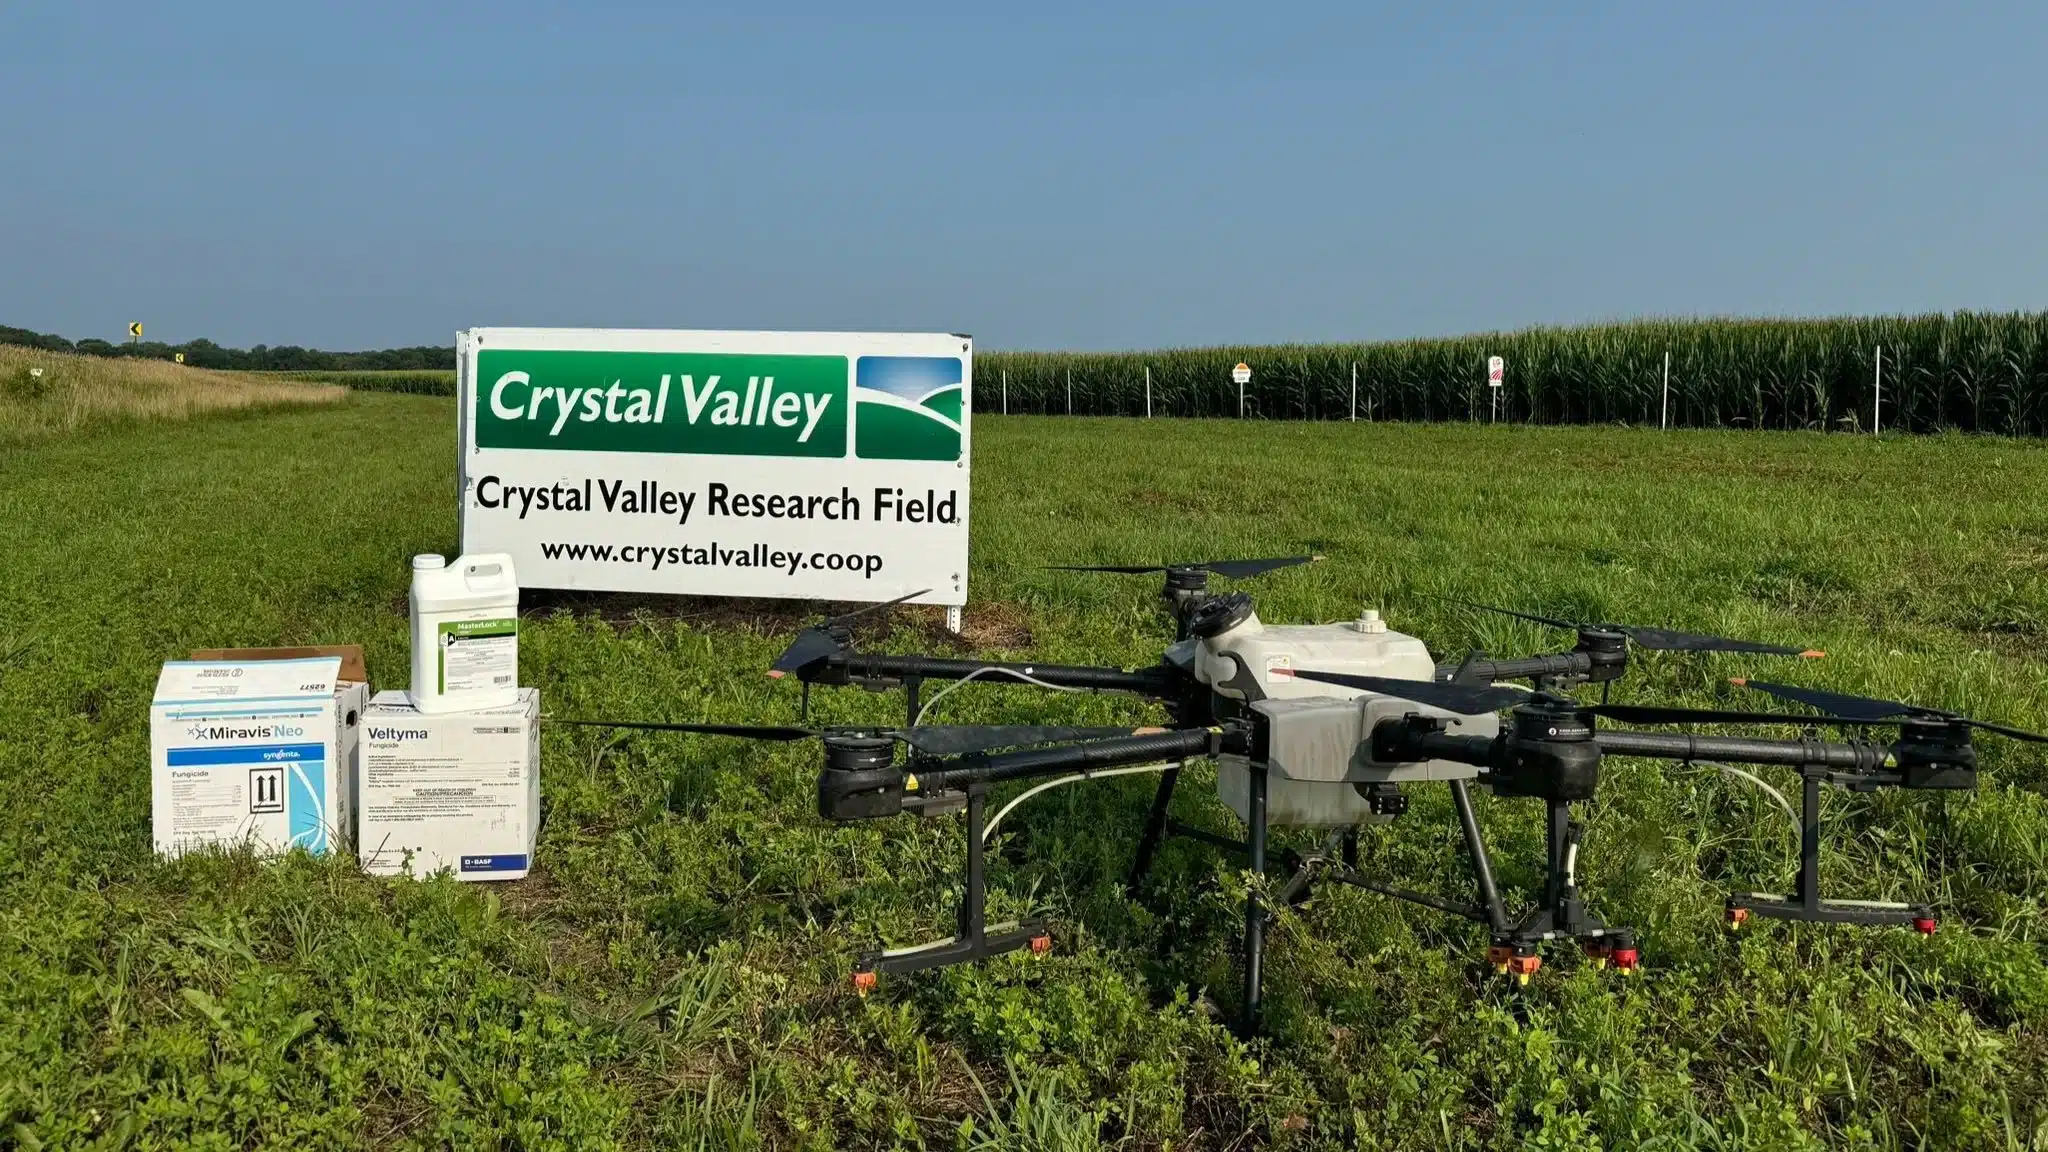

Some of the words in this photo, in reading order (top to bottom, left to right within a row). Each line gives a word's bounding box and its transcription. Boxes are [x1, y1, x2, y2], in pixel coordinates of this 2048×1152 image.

[489, 370, 672, 436] Crystal
[680, 374, 833, 443] Valley
[476, 475, 591, 519] Crystal
[597, 479, 697, 525] Valley
[708, 482, 860, 521] Research
[874, 488, 957, 524] Field
[540, 541, 883, 579] www.crystalvalley.coop
[209, 725, 271, 740] Miravis
[273, 723, 304, 738] Neo
[367, 727, 428, 742] Veltyma
